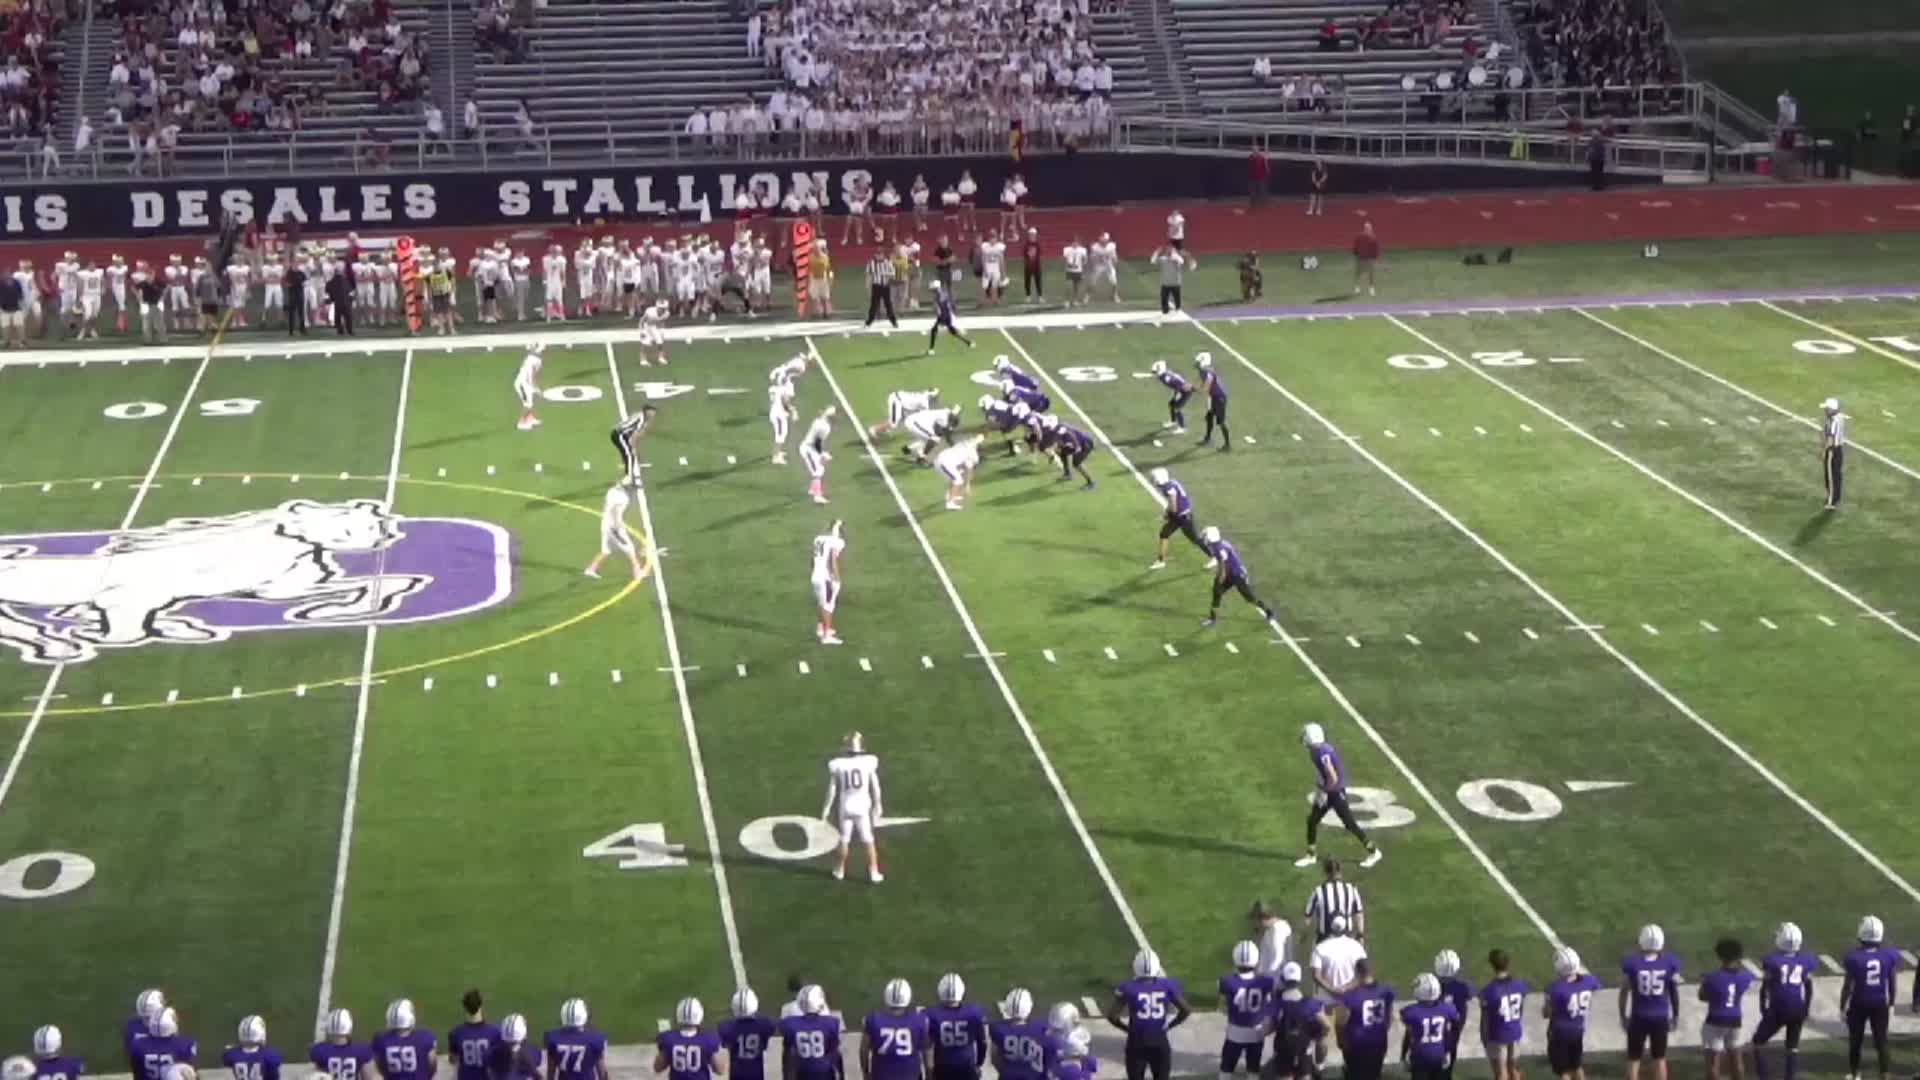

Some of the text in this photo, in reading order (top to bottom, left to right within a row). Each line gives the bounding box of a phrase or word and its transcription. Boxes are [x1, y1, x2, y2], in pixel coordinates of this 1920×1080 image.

[4, 169, 873, 232] IS DESALES STALLIONS
[844, 768, 863, 790] 10
[1637, 969, 1666, 996] 85
[1780, 964, 1802, 985] 14
[1866, 959, 1881, 985] 2
[1136, 991, 1166, 1020] 35
[1234, 987, 1262, 1013] 40
[1499, 993, 1523, 1022] 42
[1724, 983, 1736, 1008] 1
[878, 1027, 913, 1056] 79
[939, 1020, 969, 1047] 65
[1420, 1016, 1446, 1044] 13
[557, 1044, 587, 1072] 77
[736, 1034, 760, 1059] 19
[796, 1031, 825, 1059] 68
[385, 1046, 417, 1073] 59
[672, 1045, 702, 1073] 60
